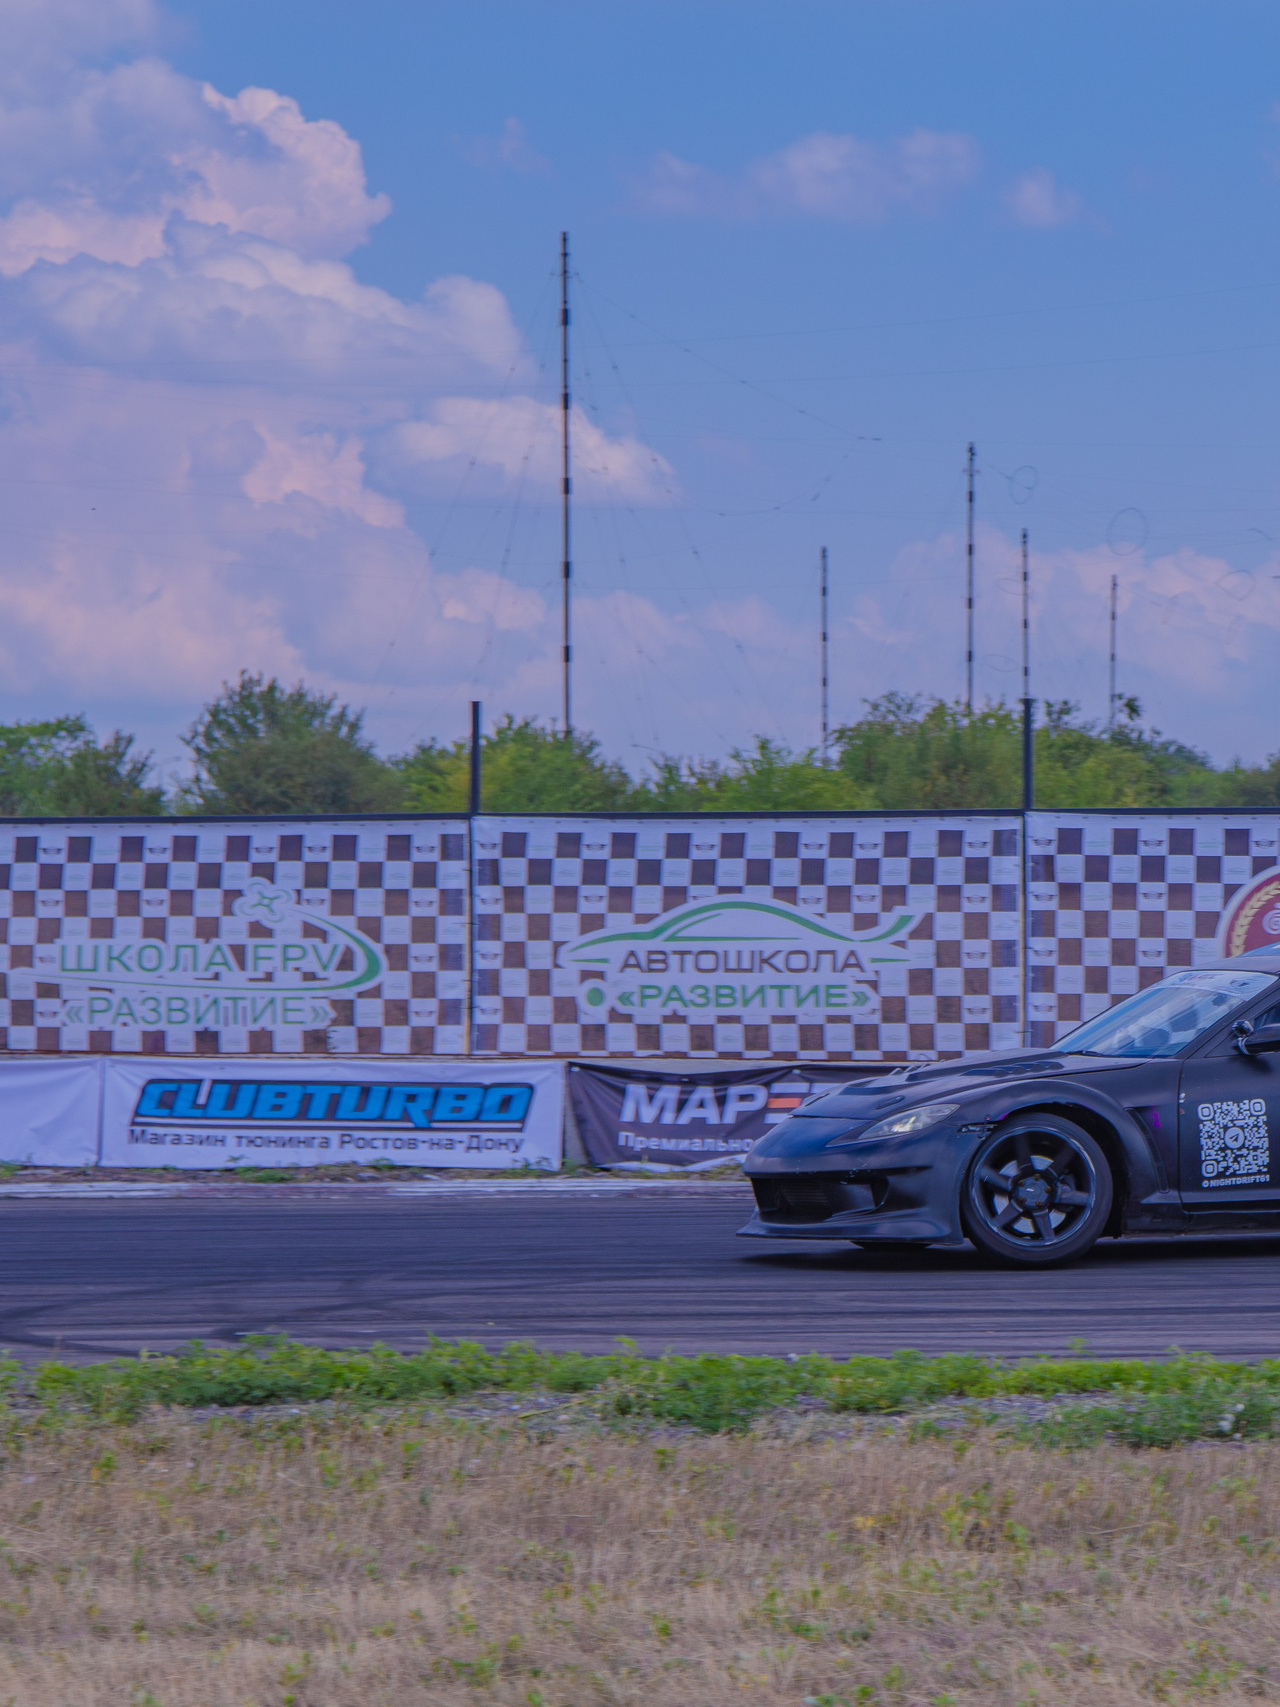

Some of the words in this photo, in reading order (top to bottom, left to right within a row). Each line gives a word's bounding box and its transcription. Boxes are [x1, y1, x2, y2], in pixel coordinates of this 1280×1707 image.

[60, 944, 235, 972] ШКОЛА
[252, 944, 345, 972] FPV
[618, 950, 868, 973] АВТОШКОЛА
[617, 984, 870, 1008] «РАЗВИТИЕ»
[135, 1082, 535, 1128] CLUBTURBO
[619, 1082, 846, 1125] MAPE
[128, 1128, 226, 1148] Магазин
[235, 1134, 330, 1150] тюнинга
[338, 1132, 525, 1154] Ростов-на-Дону
[617, 1130, 755, 1153] Премиально
